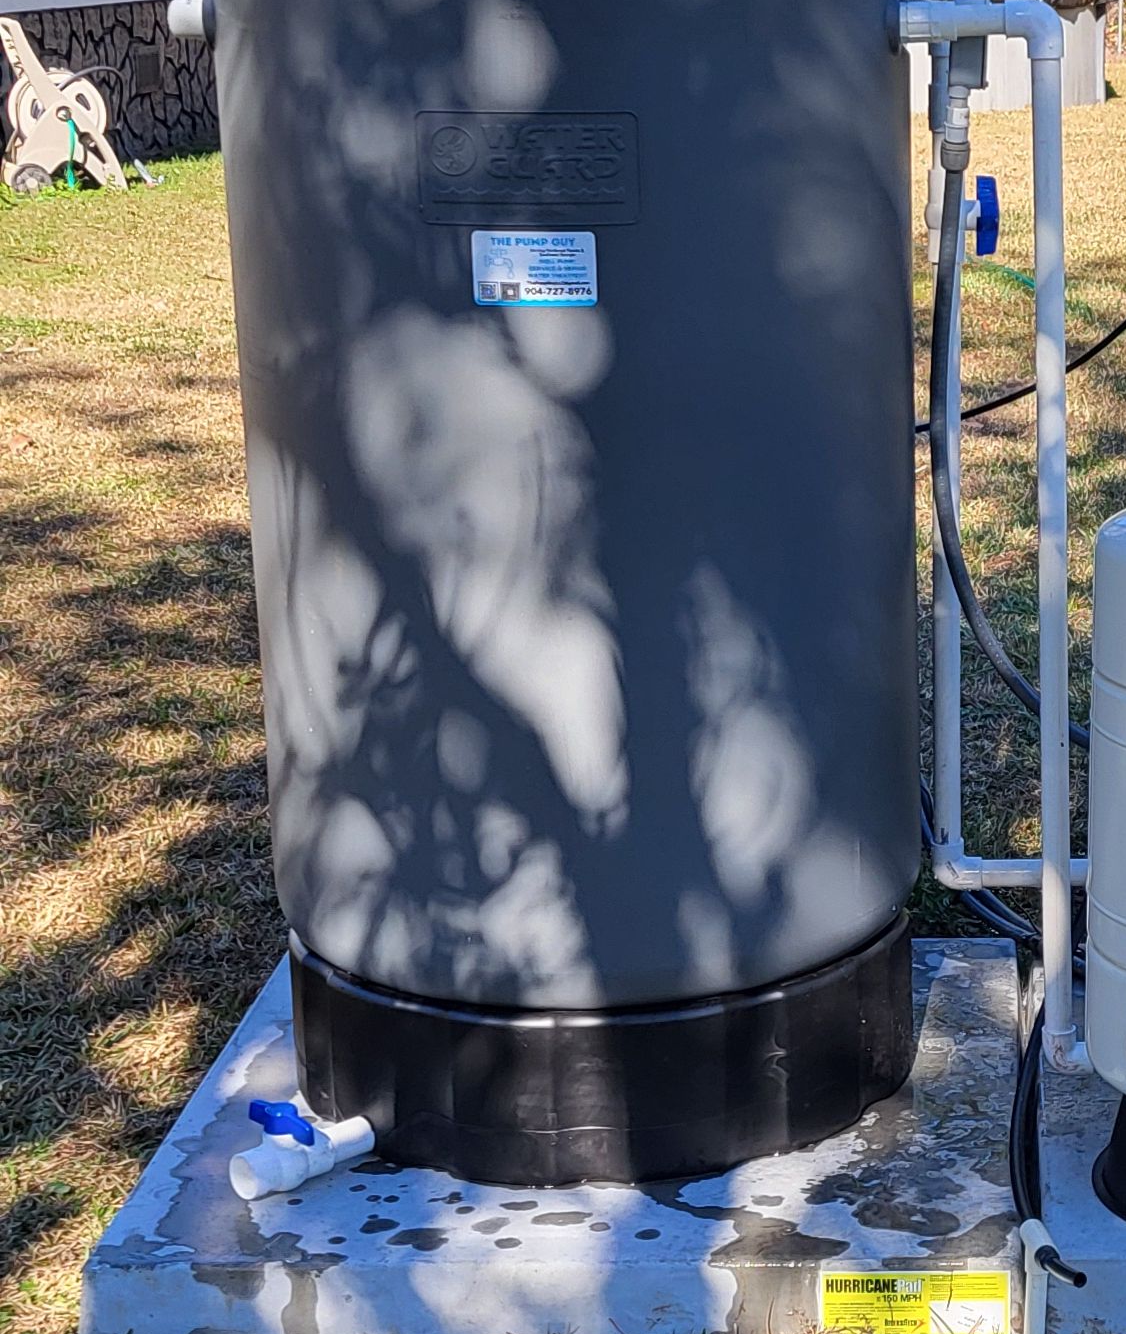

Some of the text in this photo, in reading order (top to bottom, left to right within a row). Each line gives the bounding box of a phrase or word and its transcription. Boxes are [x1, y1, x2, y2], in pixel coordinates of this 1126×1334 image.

[479, 123, 625, 151] WATER
[484, 153, 623, 182] GUARD
[491, 237, 576, 246] THE PUMP GUY
[524, 287, 593, 295] 904-727-8976
[900, 1294, 922, 1303] MPH
